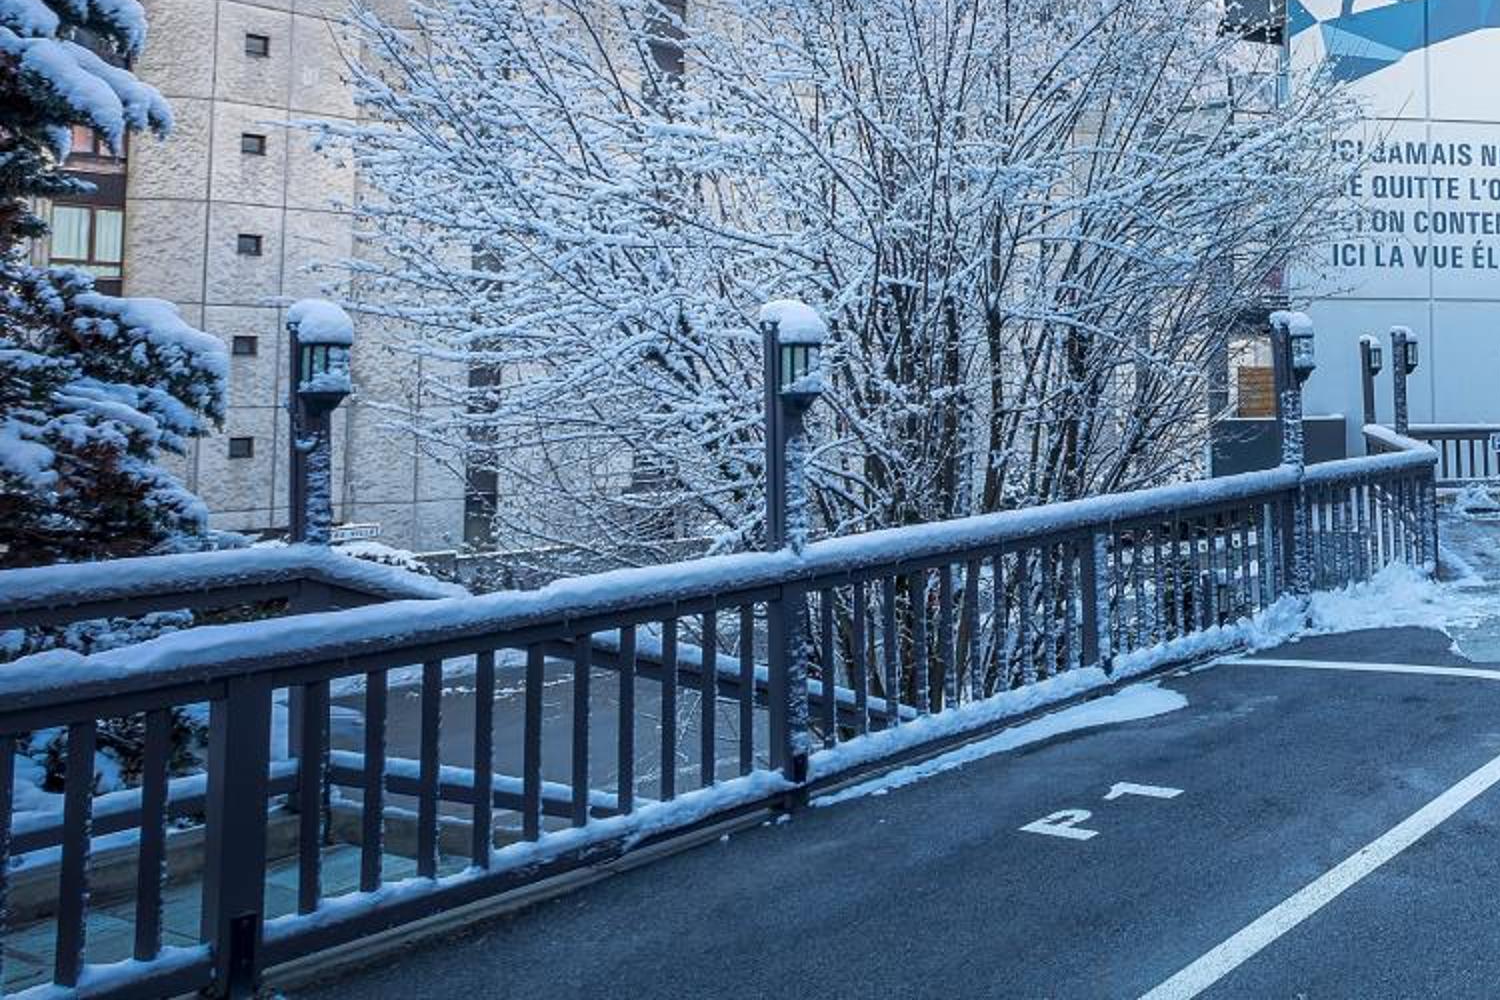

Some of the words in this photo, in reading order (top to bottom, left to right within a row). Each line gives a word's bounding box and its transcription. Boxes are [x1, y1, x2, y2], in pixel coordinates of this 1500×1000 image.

[1372, 140, 1473, 166] JAMAIS
[1372, 175, 1460, 199] QUITTE
[1333, 243, 1365, 267] ICI
[1375, 245, 1405, 267] LA
[1413, 246, 1464, 268] VUE
